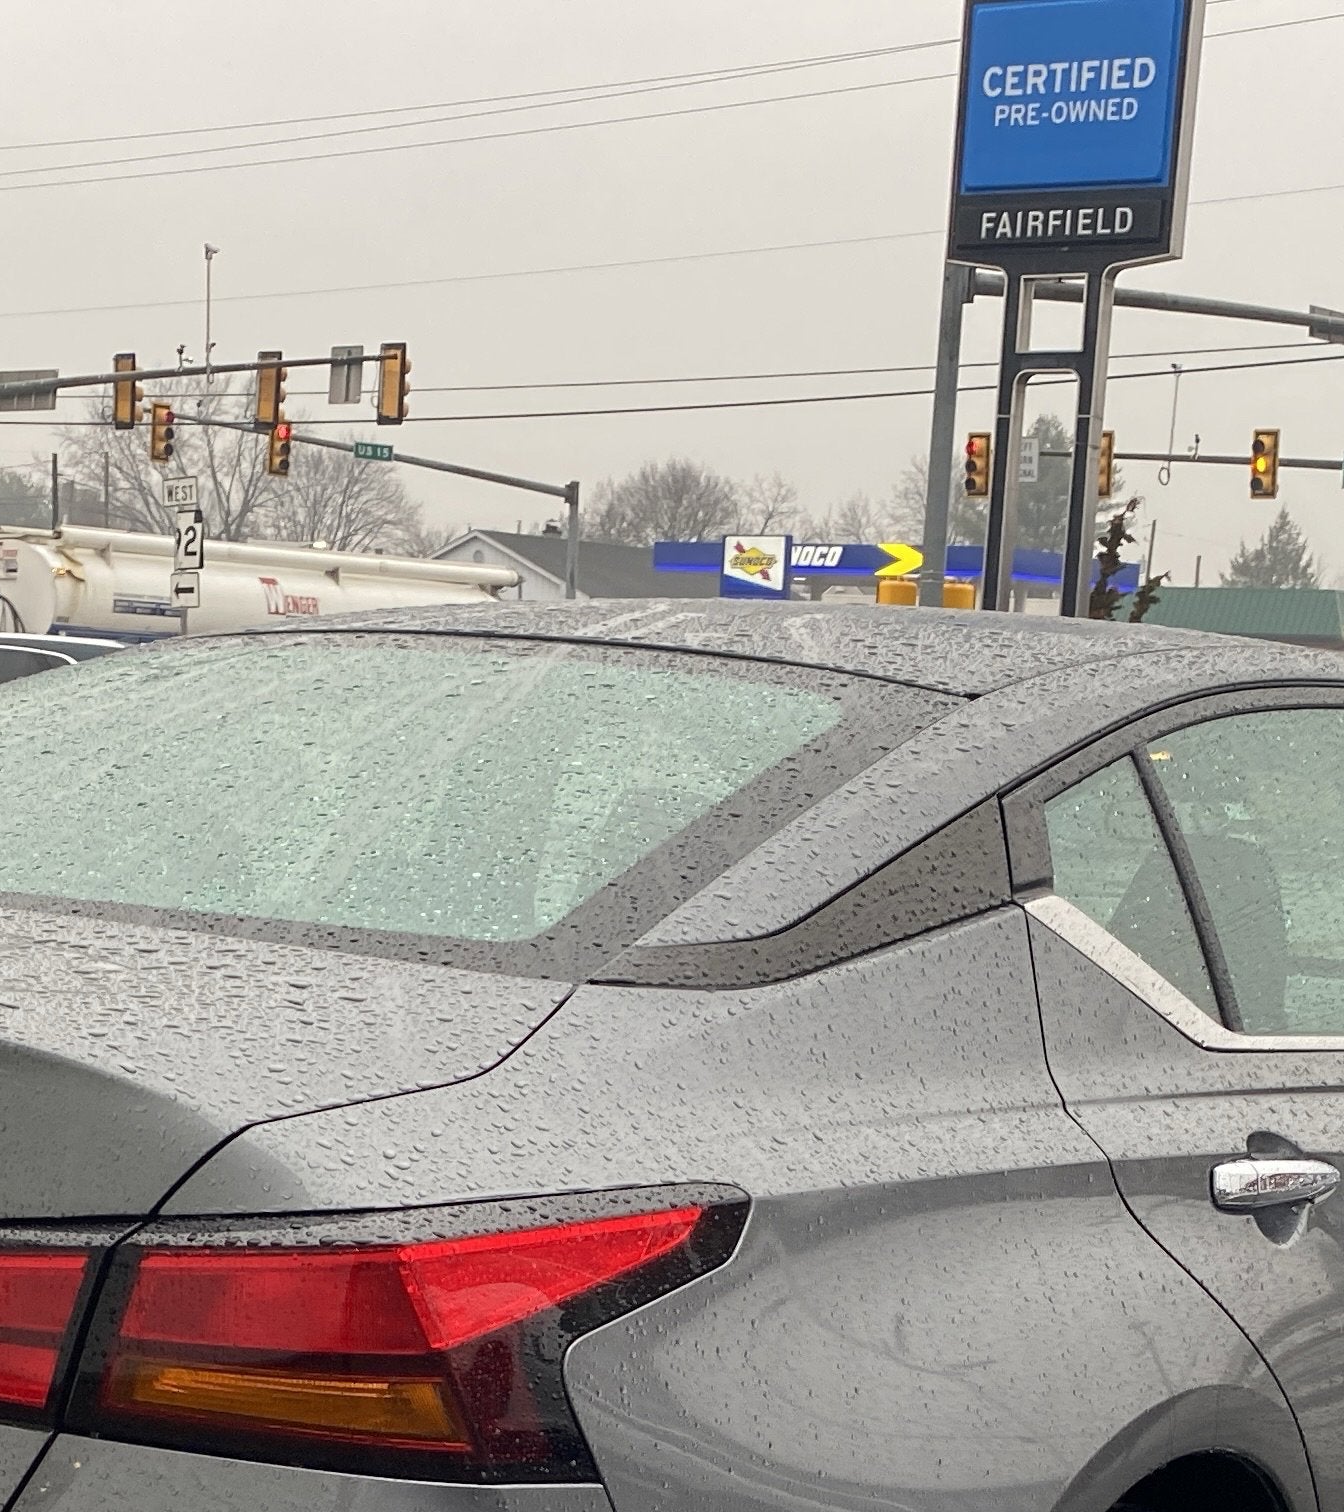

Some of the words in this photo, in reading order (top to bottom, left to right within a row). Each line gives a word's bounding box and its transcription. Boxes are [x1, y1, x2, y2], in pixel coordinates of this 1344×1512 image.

[982, 57, 1156, 98] CERTIFIED
[994, 97, 1138, 126] PRE-OWNED
[980, 207, 1134, 240] FAIRFIELD
[357, 445, 373, 457] US
[377, 447, 390, 458] 15
[166, 485, 193, 502] WEST
